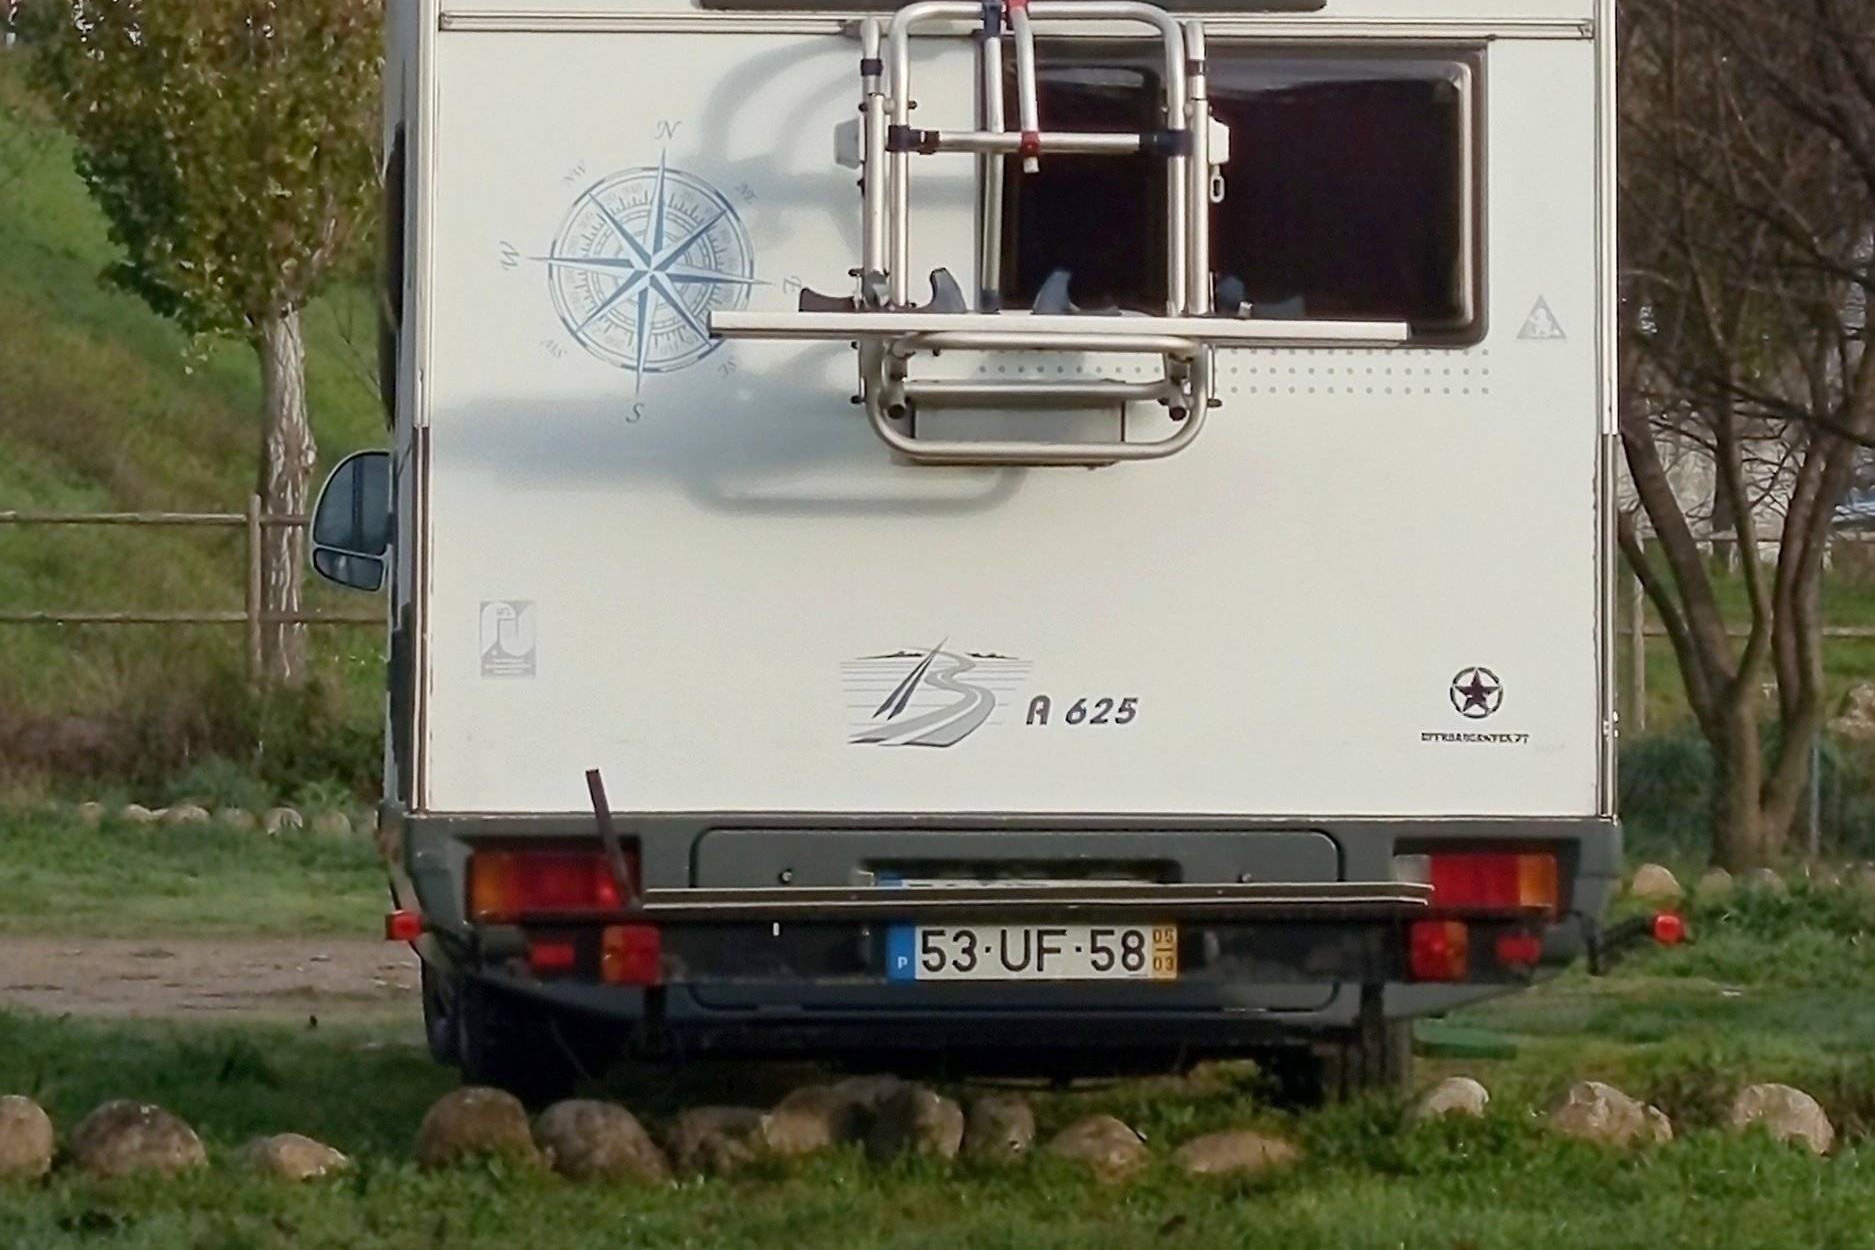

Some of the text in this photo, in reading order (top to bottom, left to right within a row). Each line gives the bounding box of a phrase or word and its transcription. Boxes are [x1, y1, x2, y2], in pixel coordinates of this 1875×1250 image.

[654, 119, 682, 140] N
[624, 402, 645, 424] S
[1026, 694, 1139, 726] A 625
[897, 956, 908, 970] P
